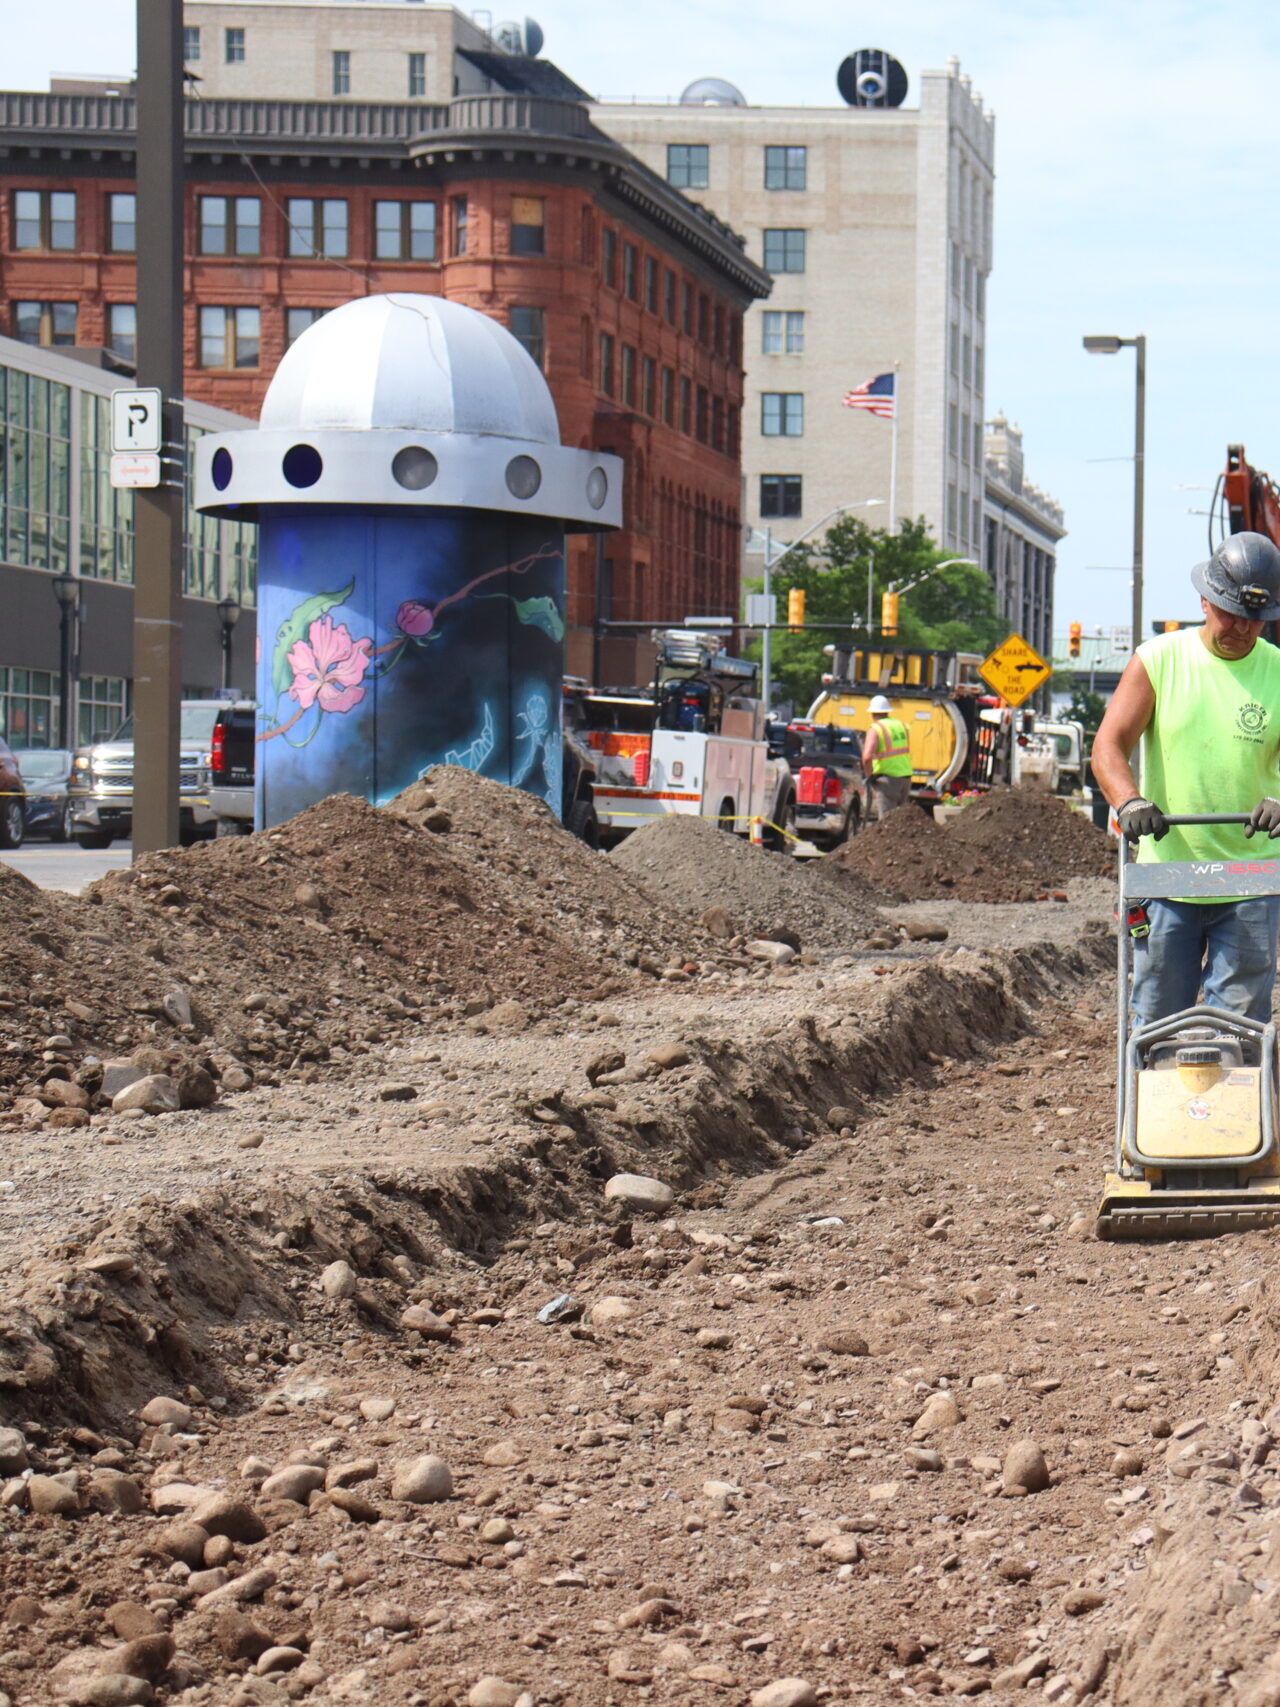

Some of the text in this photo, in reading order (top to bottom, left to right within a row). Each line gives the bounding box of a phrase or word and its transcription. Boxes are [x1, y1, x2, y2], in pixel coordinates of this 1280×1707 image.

[128, 404, 148, 438] P
[1002, 648, 1028, 657] SHARE
[1007, 675, 1021, 684] THE
[1003, 686, 1025, 695] ROAD
